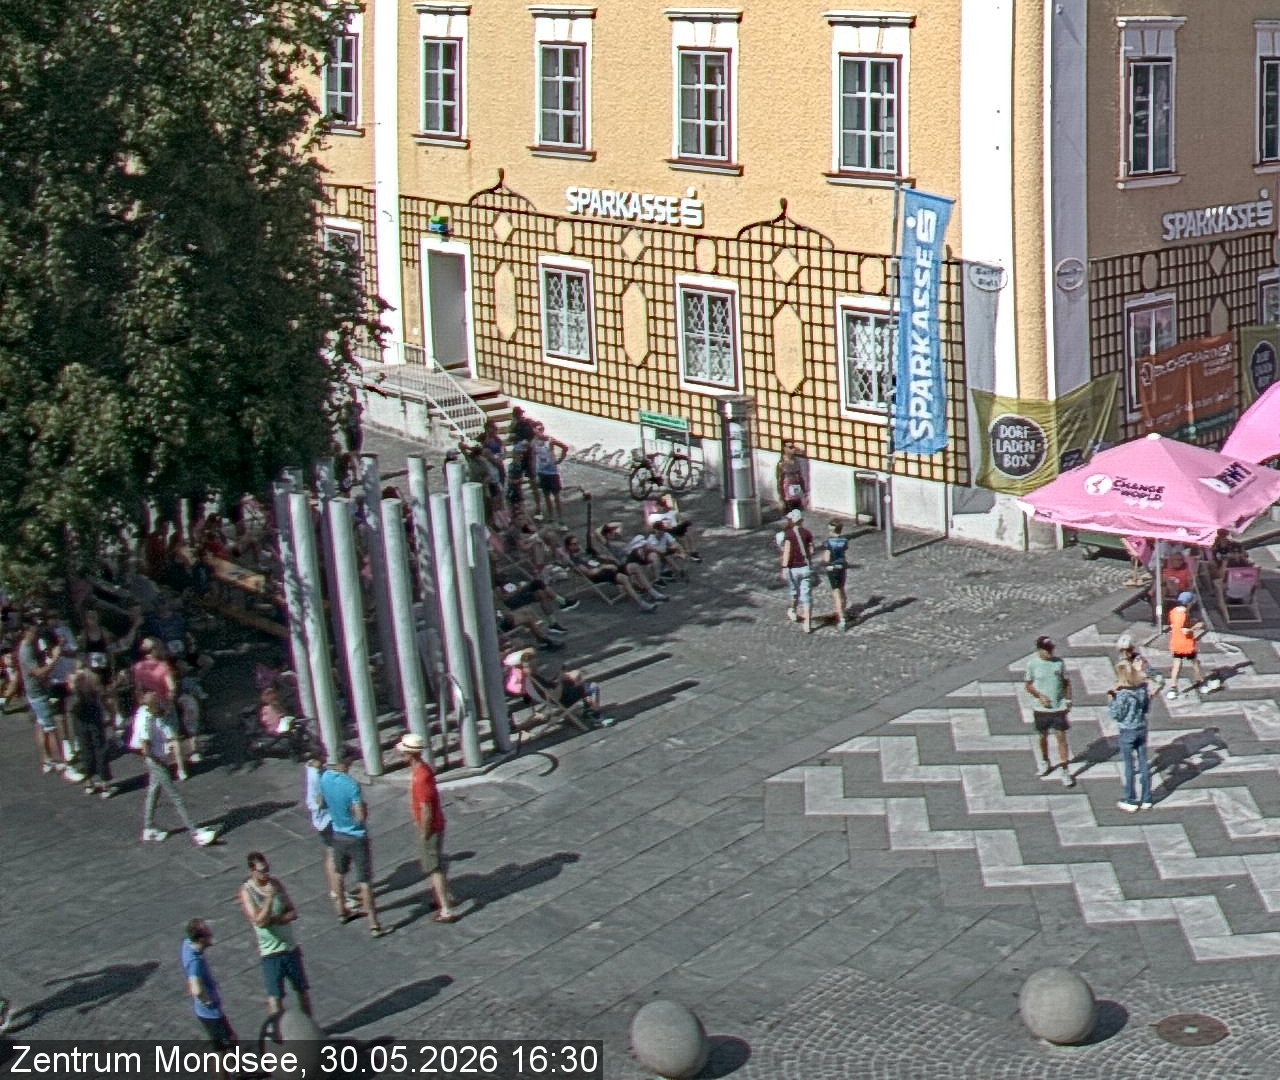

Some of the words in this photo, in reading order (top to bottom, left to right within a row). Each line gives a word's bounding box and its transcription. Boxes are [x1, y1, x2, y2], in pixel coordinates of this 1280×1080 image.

[566, 186, 680, 225] SPARKASSE
[1162, 201, 1256, 240] SPARKASSE
[909, 246, 935, 440] SPARKASSE
[1113, 479, 1165, 494] CHANGE
